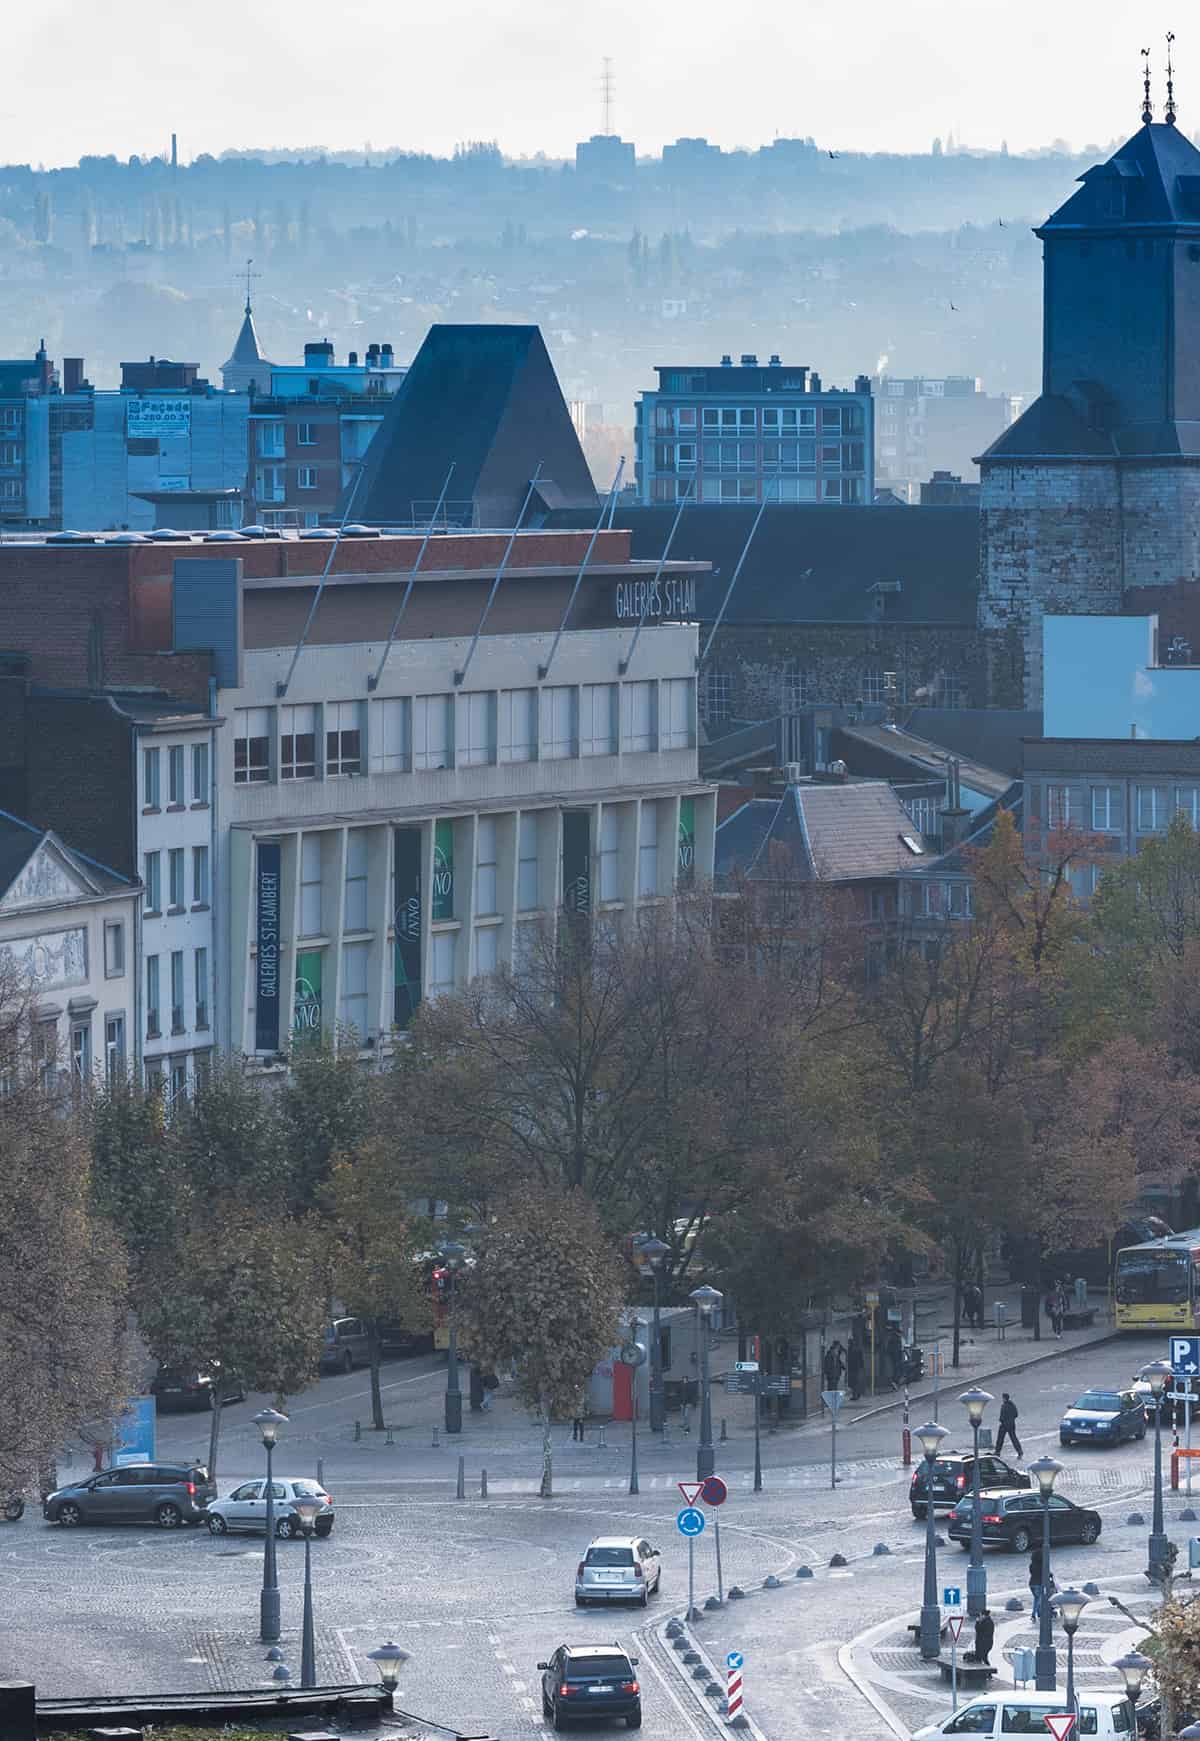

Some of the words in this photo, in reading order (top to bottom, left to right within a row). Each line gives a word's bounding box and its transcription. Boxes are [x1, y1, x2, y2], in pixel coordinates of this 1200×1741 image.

[616, 581, 661, 618] GALERIES
[260, 950, 278, 998] GALERIES
[1174, 1340, 1191, 1364] P
